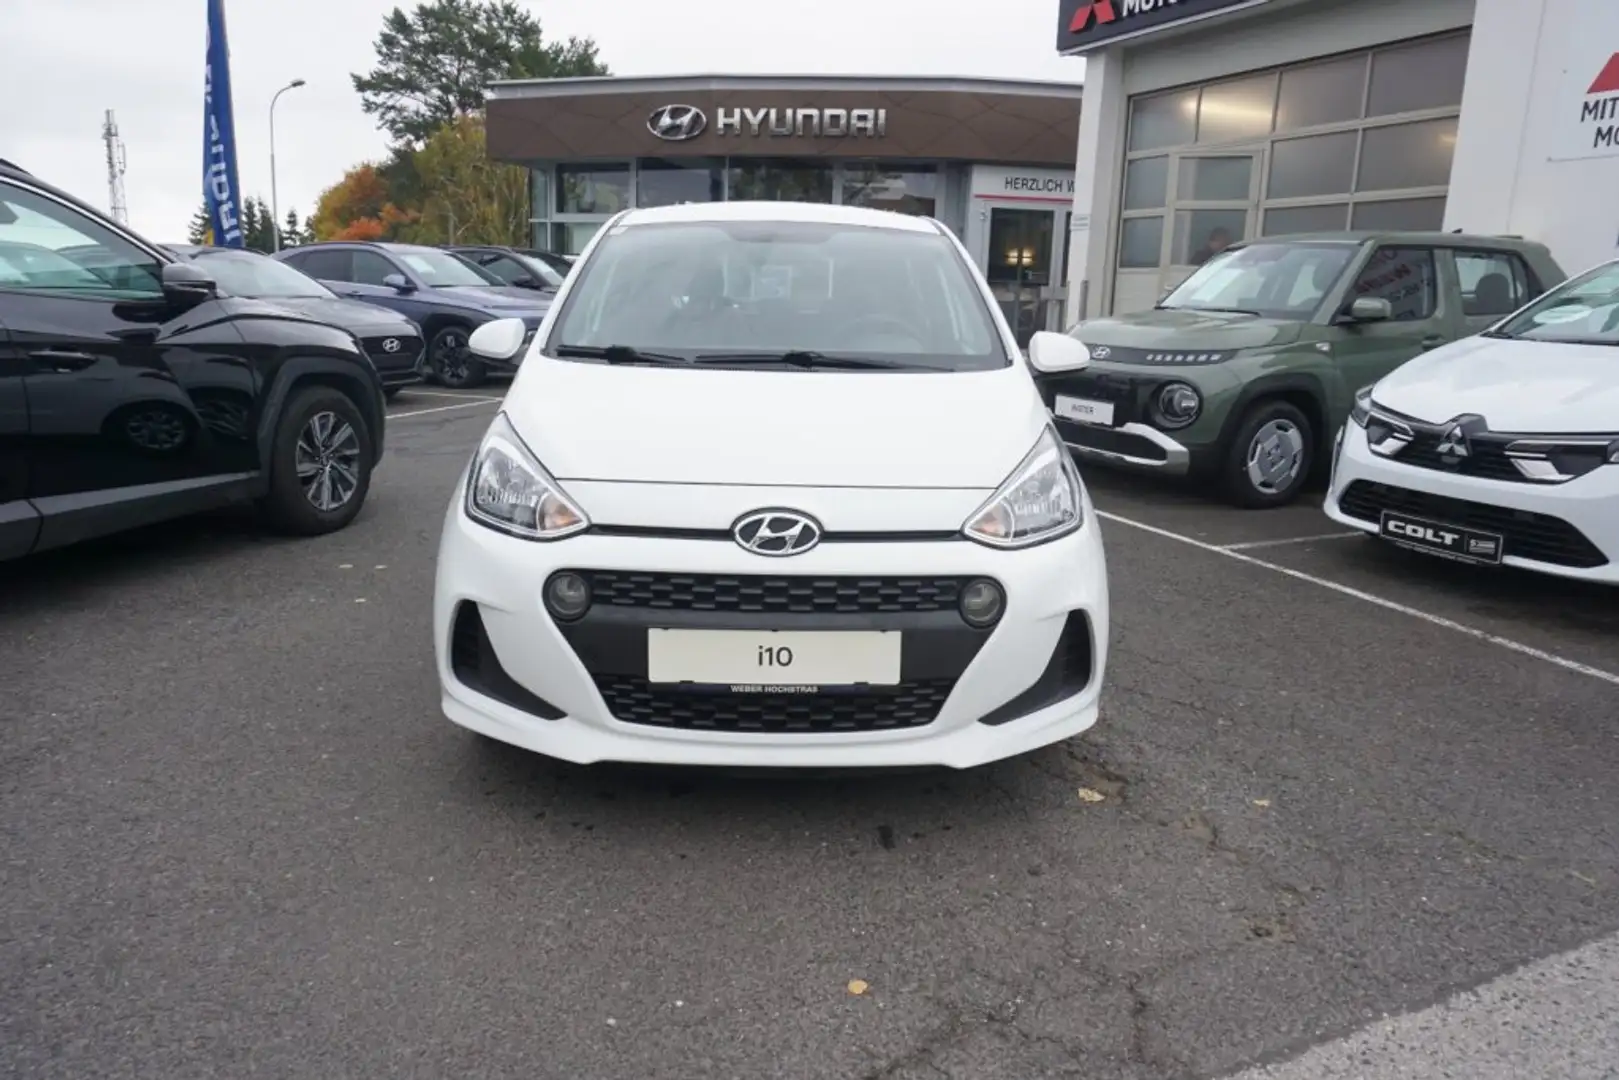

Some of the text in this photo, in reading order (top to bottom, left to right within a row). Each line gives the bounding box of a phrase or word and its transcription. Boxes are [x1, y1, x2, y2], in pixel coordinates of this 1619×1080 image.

[716, 107, 887, 138] HYUNDAI
[1005, 176, 1063, 193] HERZLICH
[1387, 520, 1461, 546] COLT
[758, 644, 794, 667] i10
[730, 684, 763, 693] WEBER
